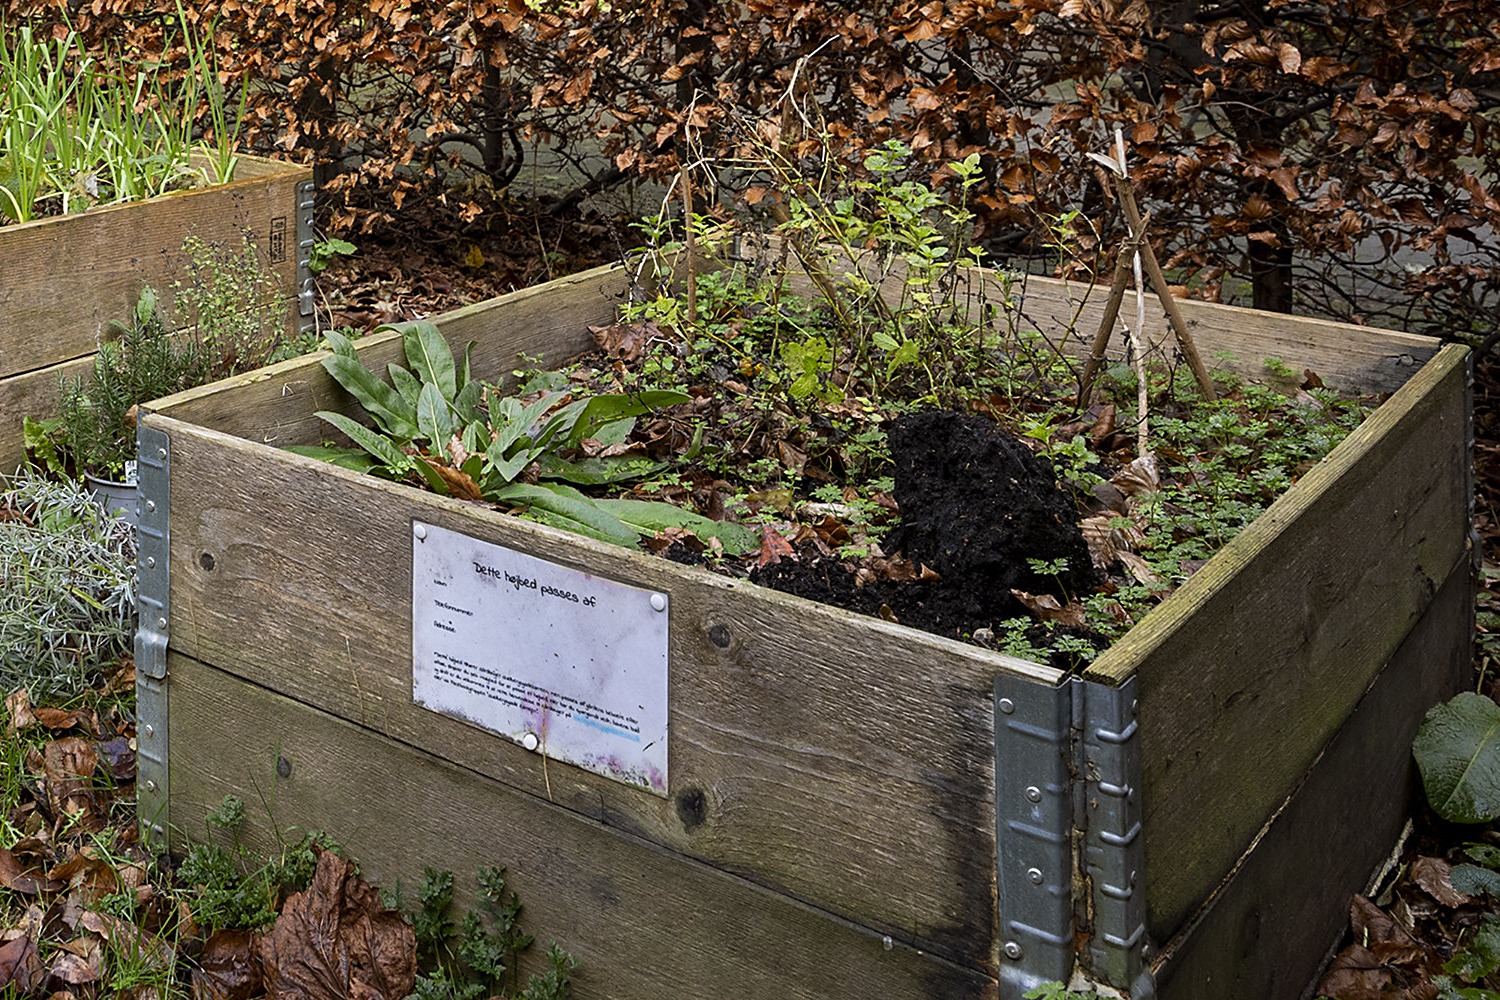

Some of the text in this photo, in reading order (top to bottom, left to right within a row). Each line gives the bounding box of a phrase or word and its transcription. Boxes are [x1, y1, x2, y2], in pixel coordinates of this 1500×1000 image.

[473, 562, 597, 607] Dette højbed passes af
